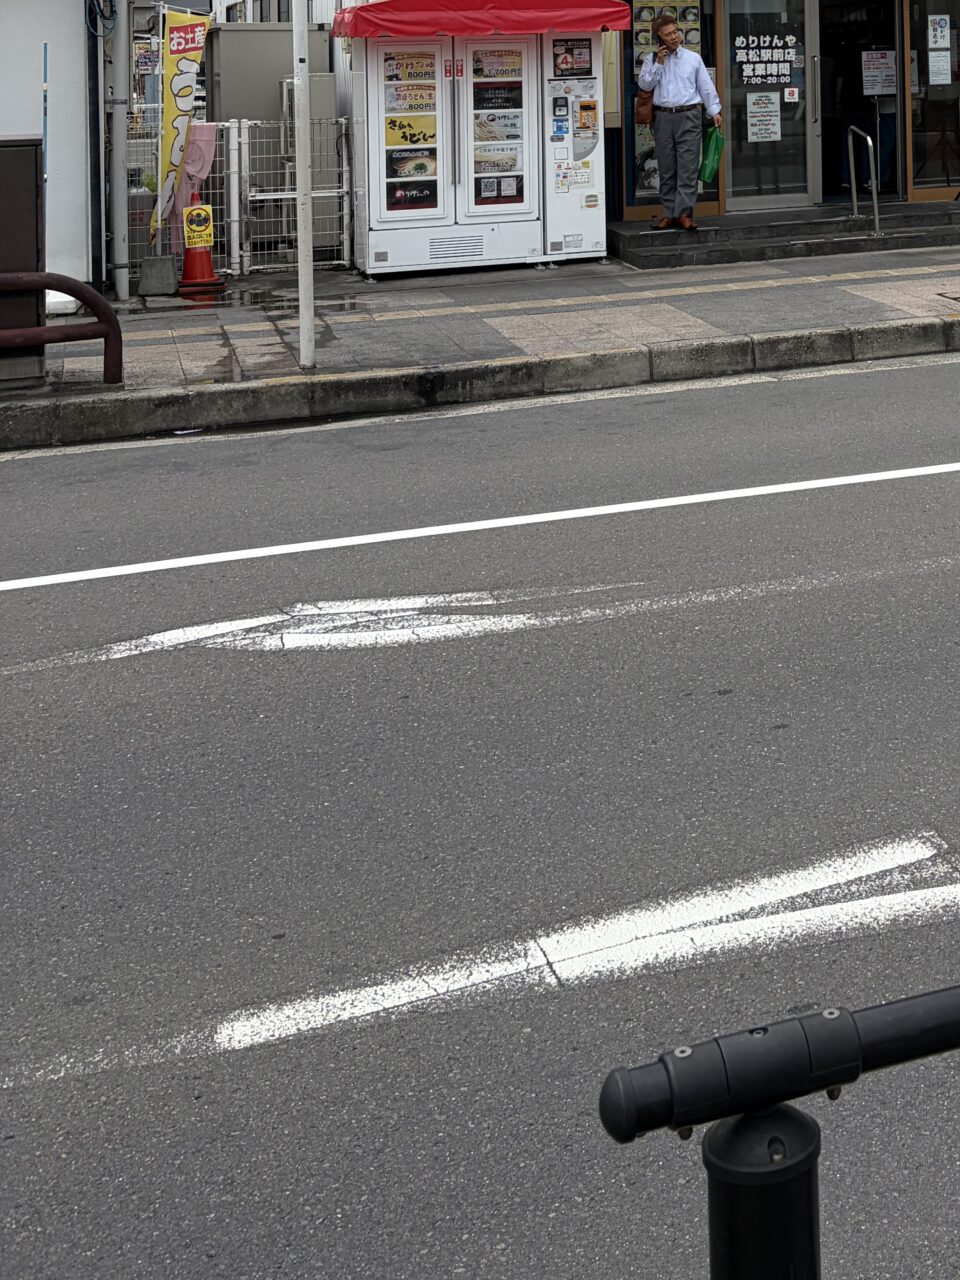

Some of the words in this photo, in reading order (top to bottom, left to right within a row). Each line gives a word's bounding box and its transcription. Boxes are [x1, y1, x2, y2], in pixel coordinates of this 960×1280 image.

[170, 26, 205, 51] お土産
[735, 35, 797, 48] めりけんや
[735, 49, 796, 62] 高松駅前店
[742, 63, 790, 76] 営業時間
[400, 131, 436, 144] うどん
